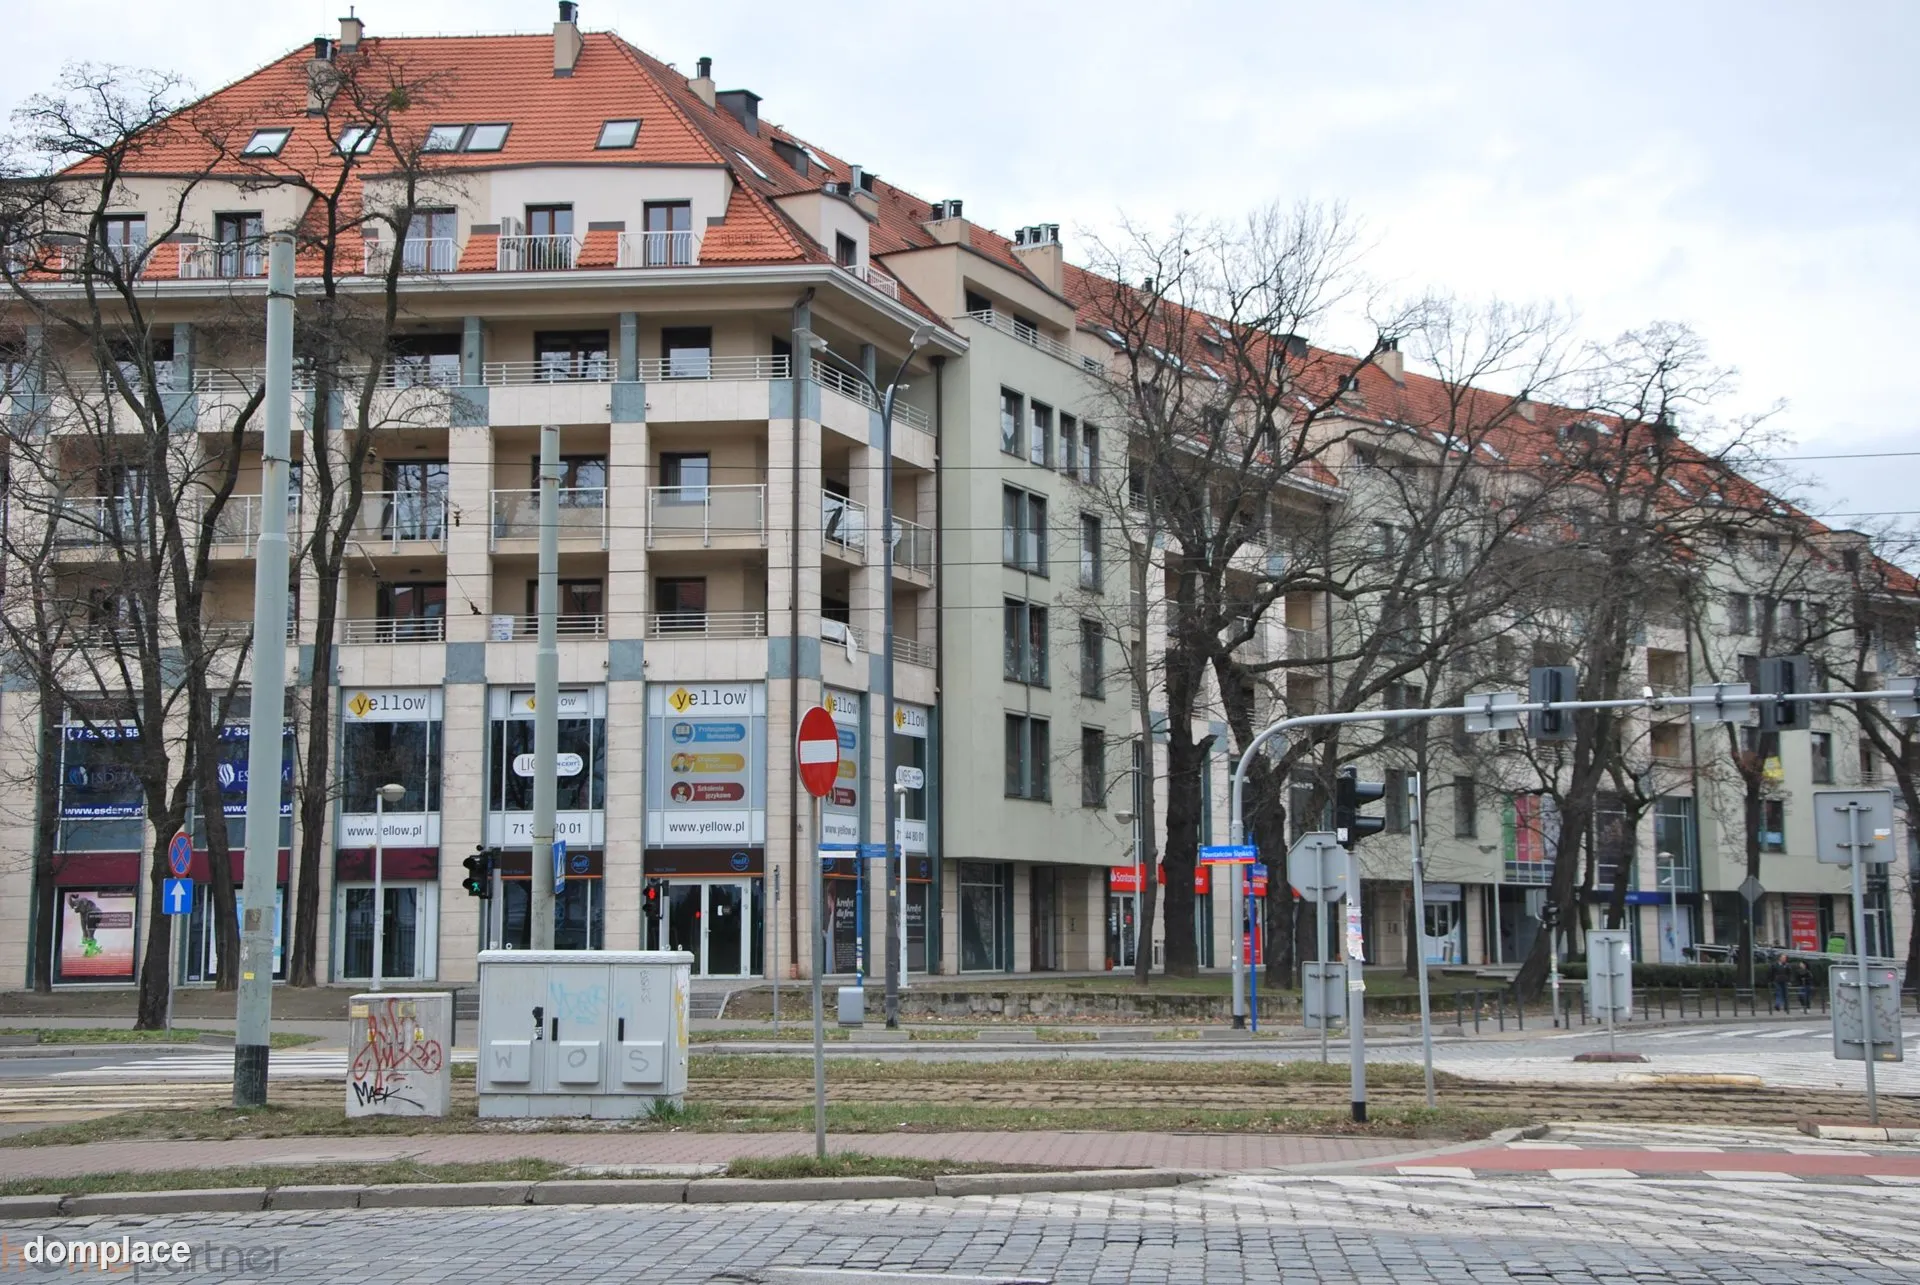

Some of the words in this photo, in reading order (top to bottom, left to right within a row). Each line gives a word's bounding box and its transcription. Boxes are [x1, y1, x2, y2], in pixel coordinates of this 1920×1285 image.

[357, 695, 425, 714] yellow
[676, 690, 746, 709] yellow
[828, 697, 857, 715] yellow
[897, 711, 925, 729] yellow
[347, 825, 422, 838] www.ellow.pl
[512, 824, 525, 835] 71
[569, 823, 582, 834] 01
[669, 821, 745, 834] www.yellow.pl
[824, 823, 857, 837] www.yellow.pl
